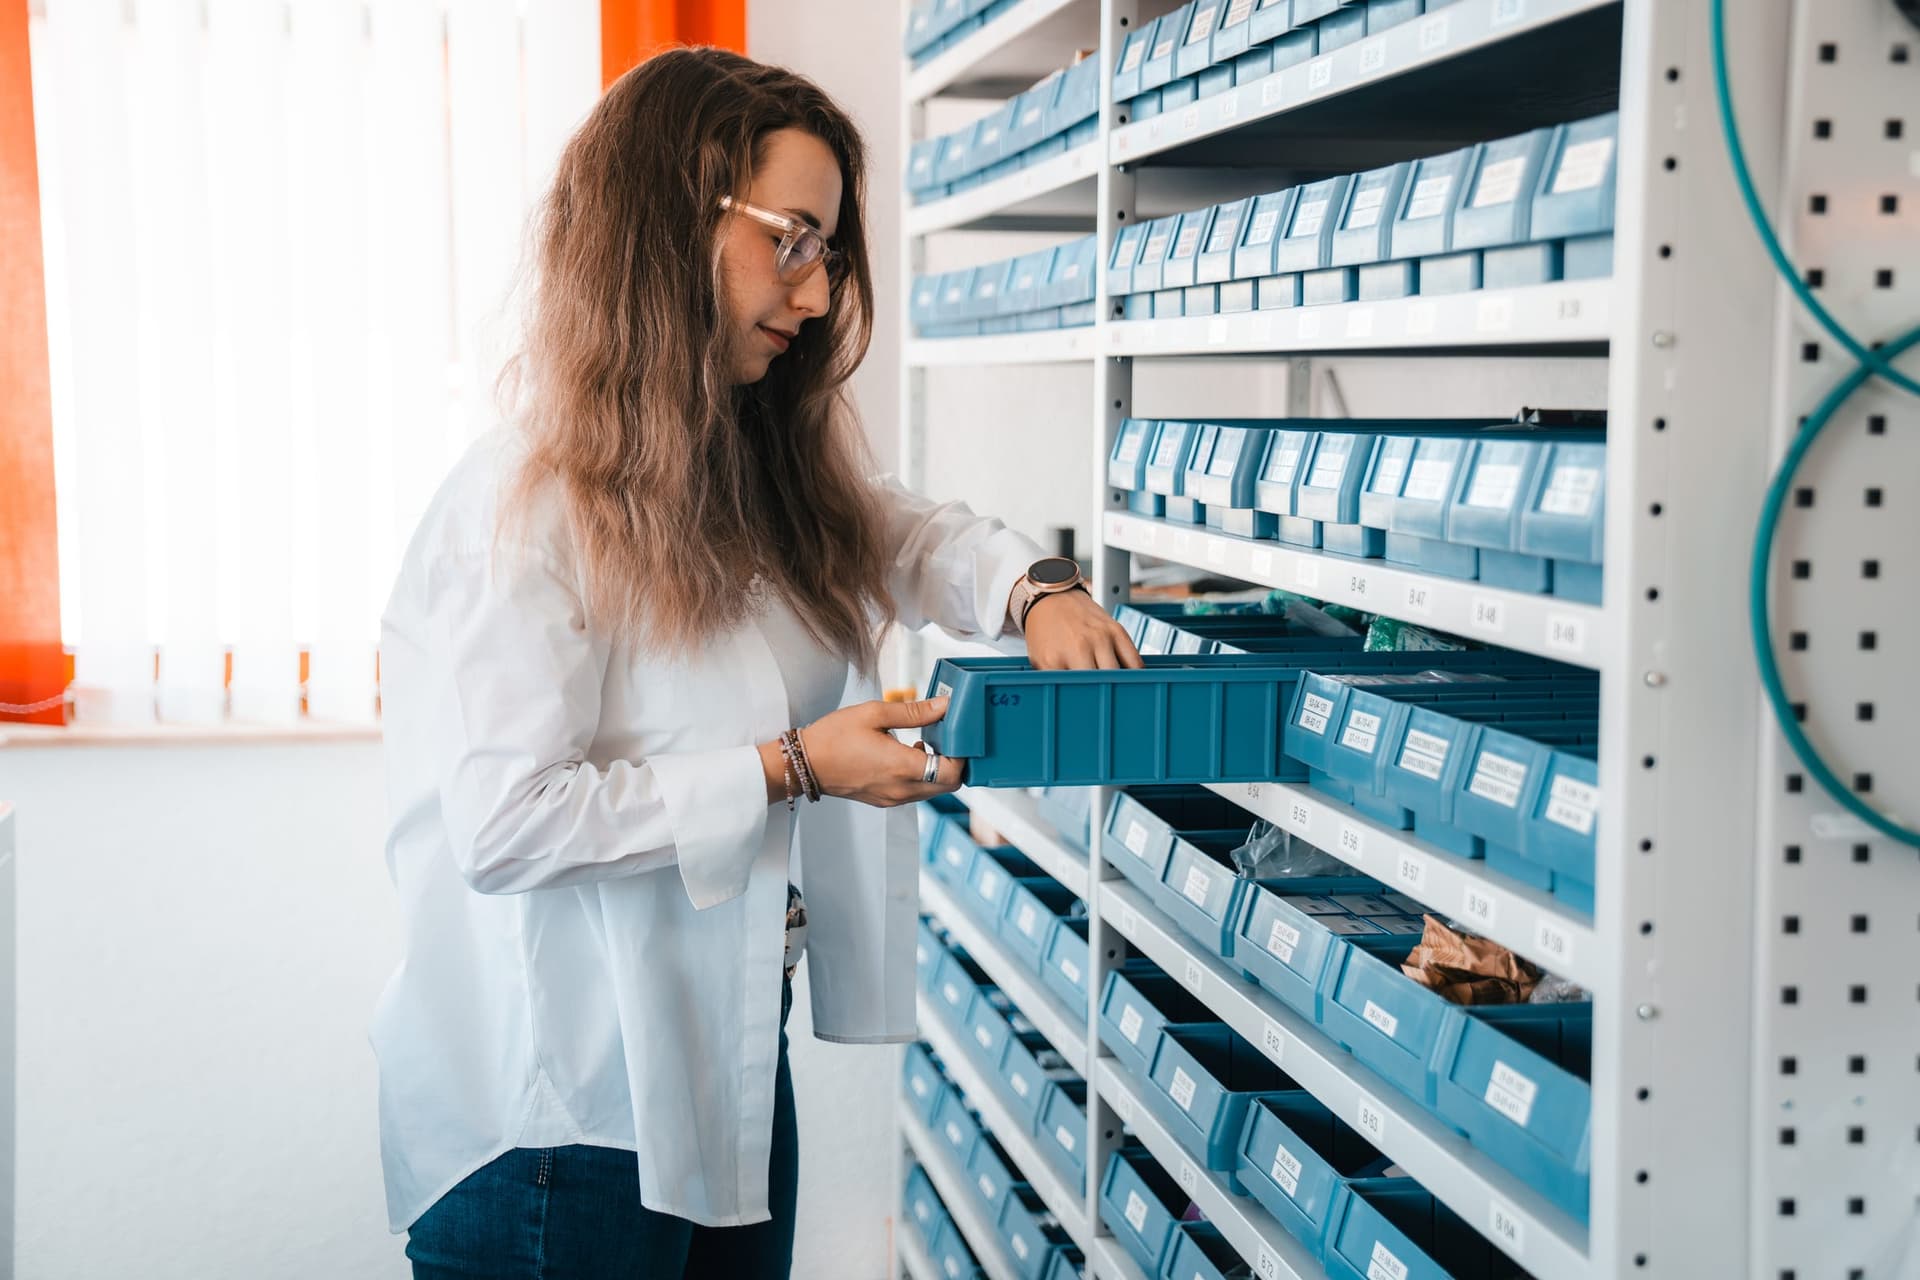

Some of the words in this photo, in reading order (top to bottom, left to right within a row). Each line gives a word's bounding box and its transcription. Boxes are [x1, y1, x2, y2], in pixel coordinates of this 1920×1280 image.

[1357, 579, 1366, 595] 46
[1415, 590, 1426, 608] 47
[1299, 808, 1307, 824] 55
[1349, 833, 1358, 851] 56
[1409, 864, 1419, 882] 57
[1272, 1034, 1280, 1052] 62
[1369, 1112, 1379, 1133] 63
[1267, 1258, 1274, 1280] 72
